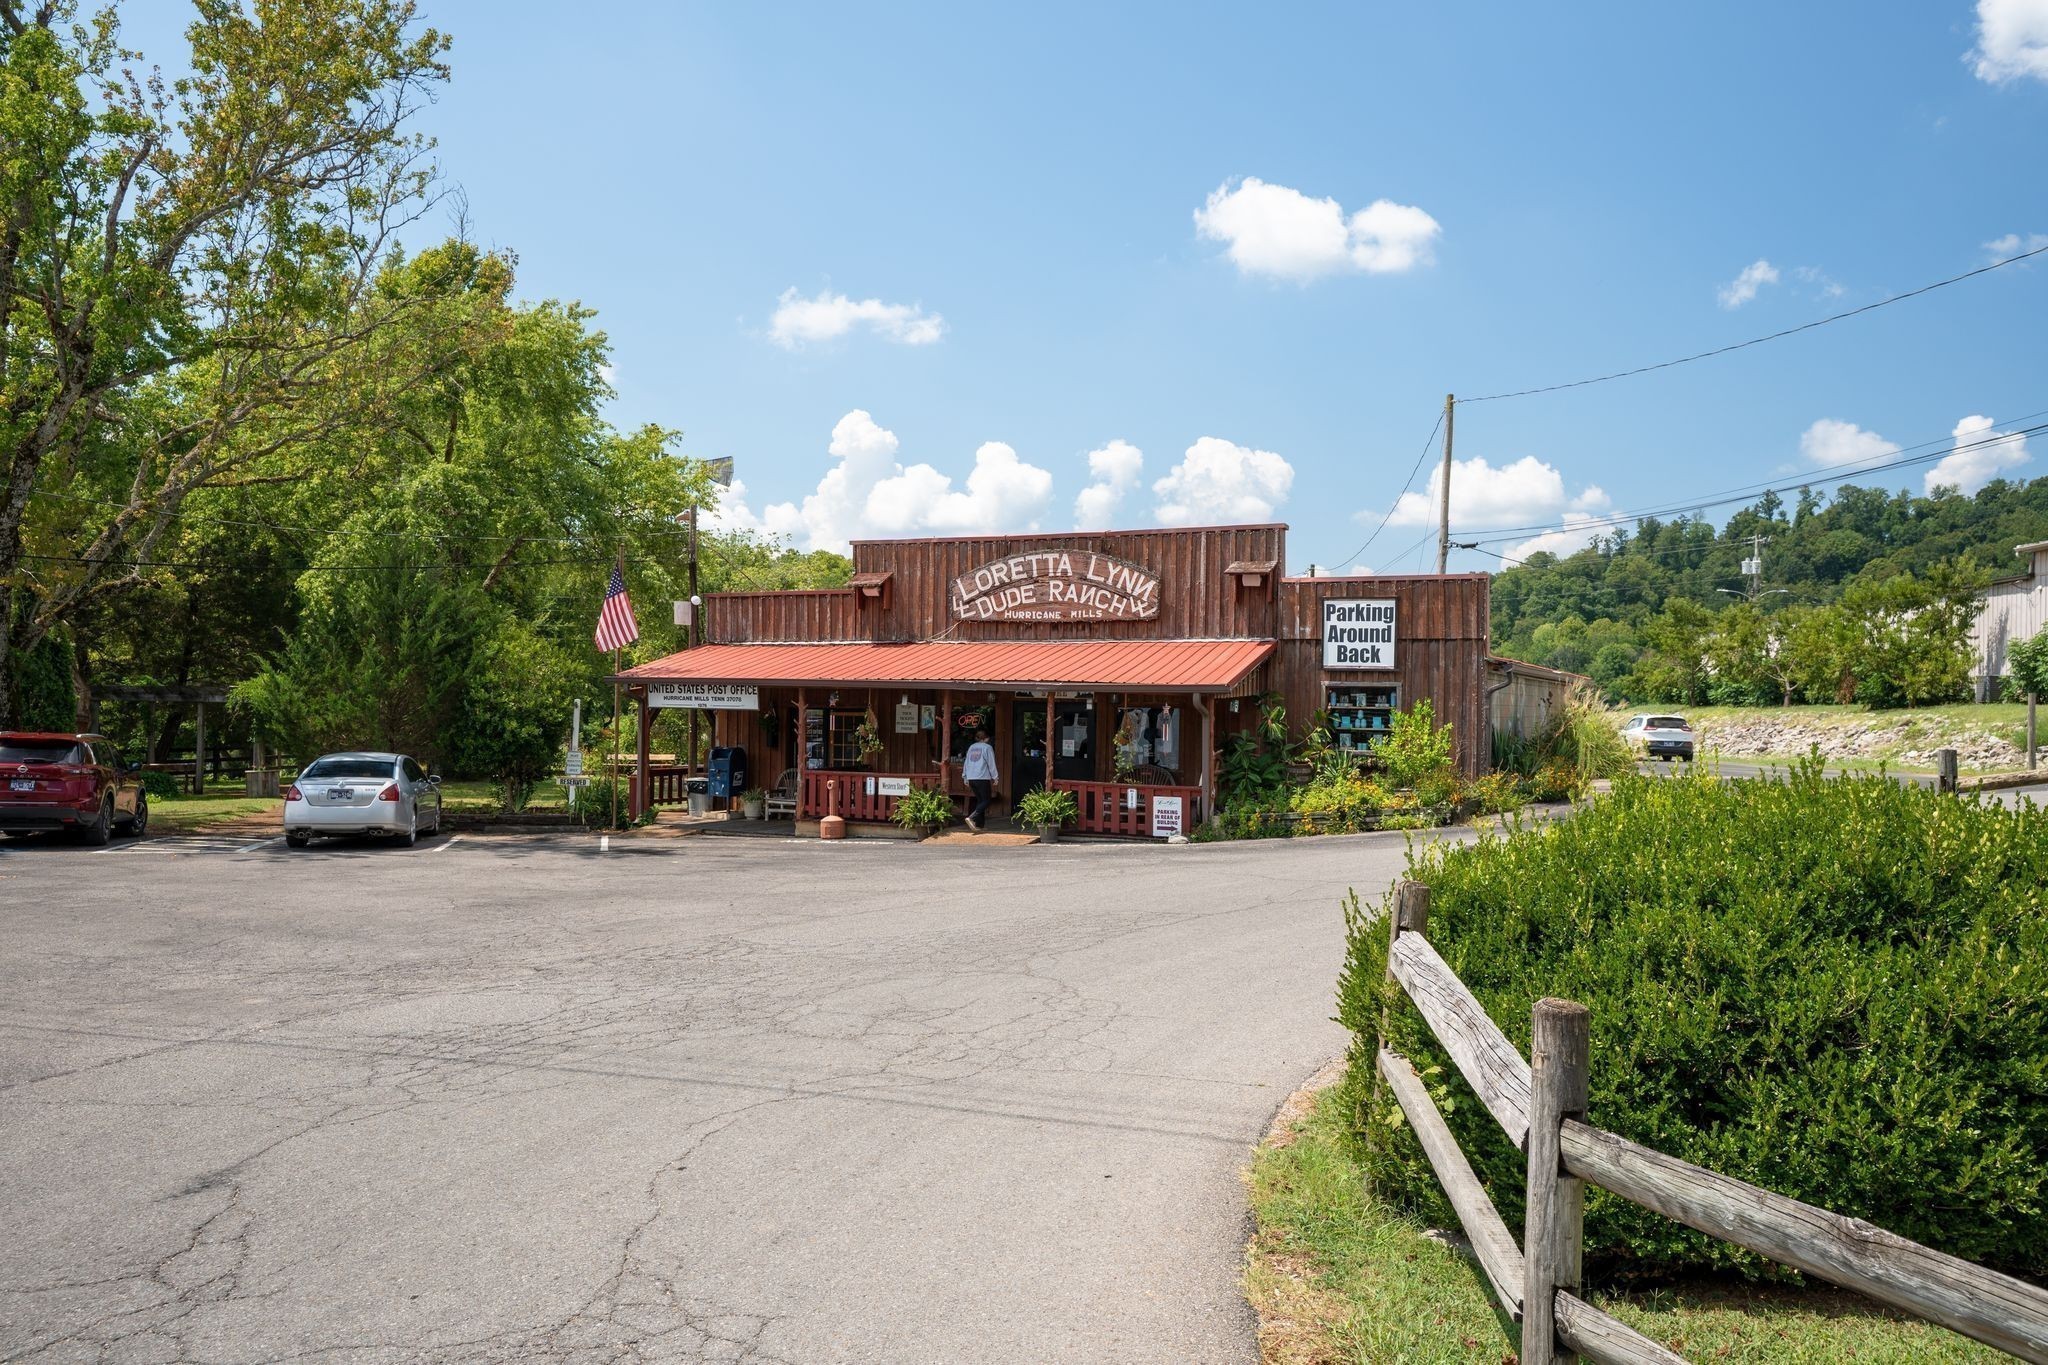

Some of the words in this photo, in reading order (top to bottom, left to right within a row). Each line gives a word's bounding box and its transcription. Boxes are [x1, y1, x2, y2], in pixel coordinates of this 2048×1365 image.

[956, 553, 1073, 601] LORETTA
[1087, 555, 1156, 602] LYNN
[975, 583, 1036, 619] DUDE
[1048, 579, 1128, 617] RANCH
[1004, 609, 1061, 619] HURRICANE
[1070, 609, 1103, 618] MILLS
[1326, 604, 1394, 624] Parking
[1328, 625, 1392, 643] Around
[1336, 645, 1381, 663] Back
[648, 683, 675, 694] UNITED
[677, 684, 705, 694] STATES
[708, 684, 727, 695] POST
[730, 684, 758, 695] OFFICE
[958, 713, 986, 727] OPEN
[882, 782, 897, 790] Western
